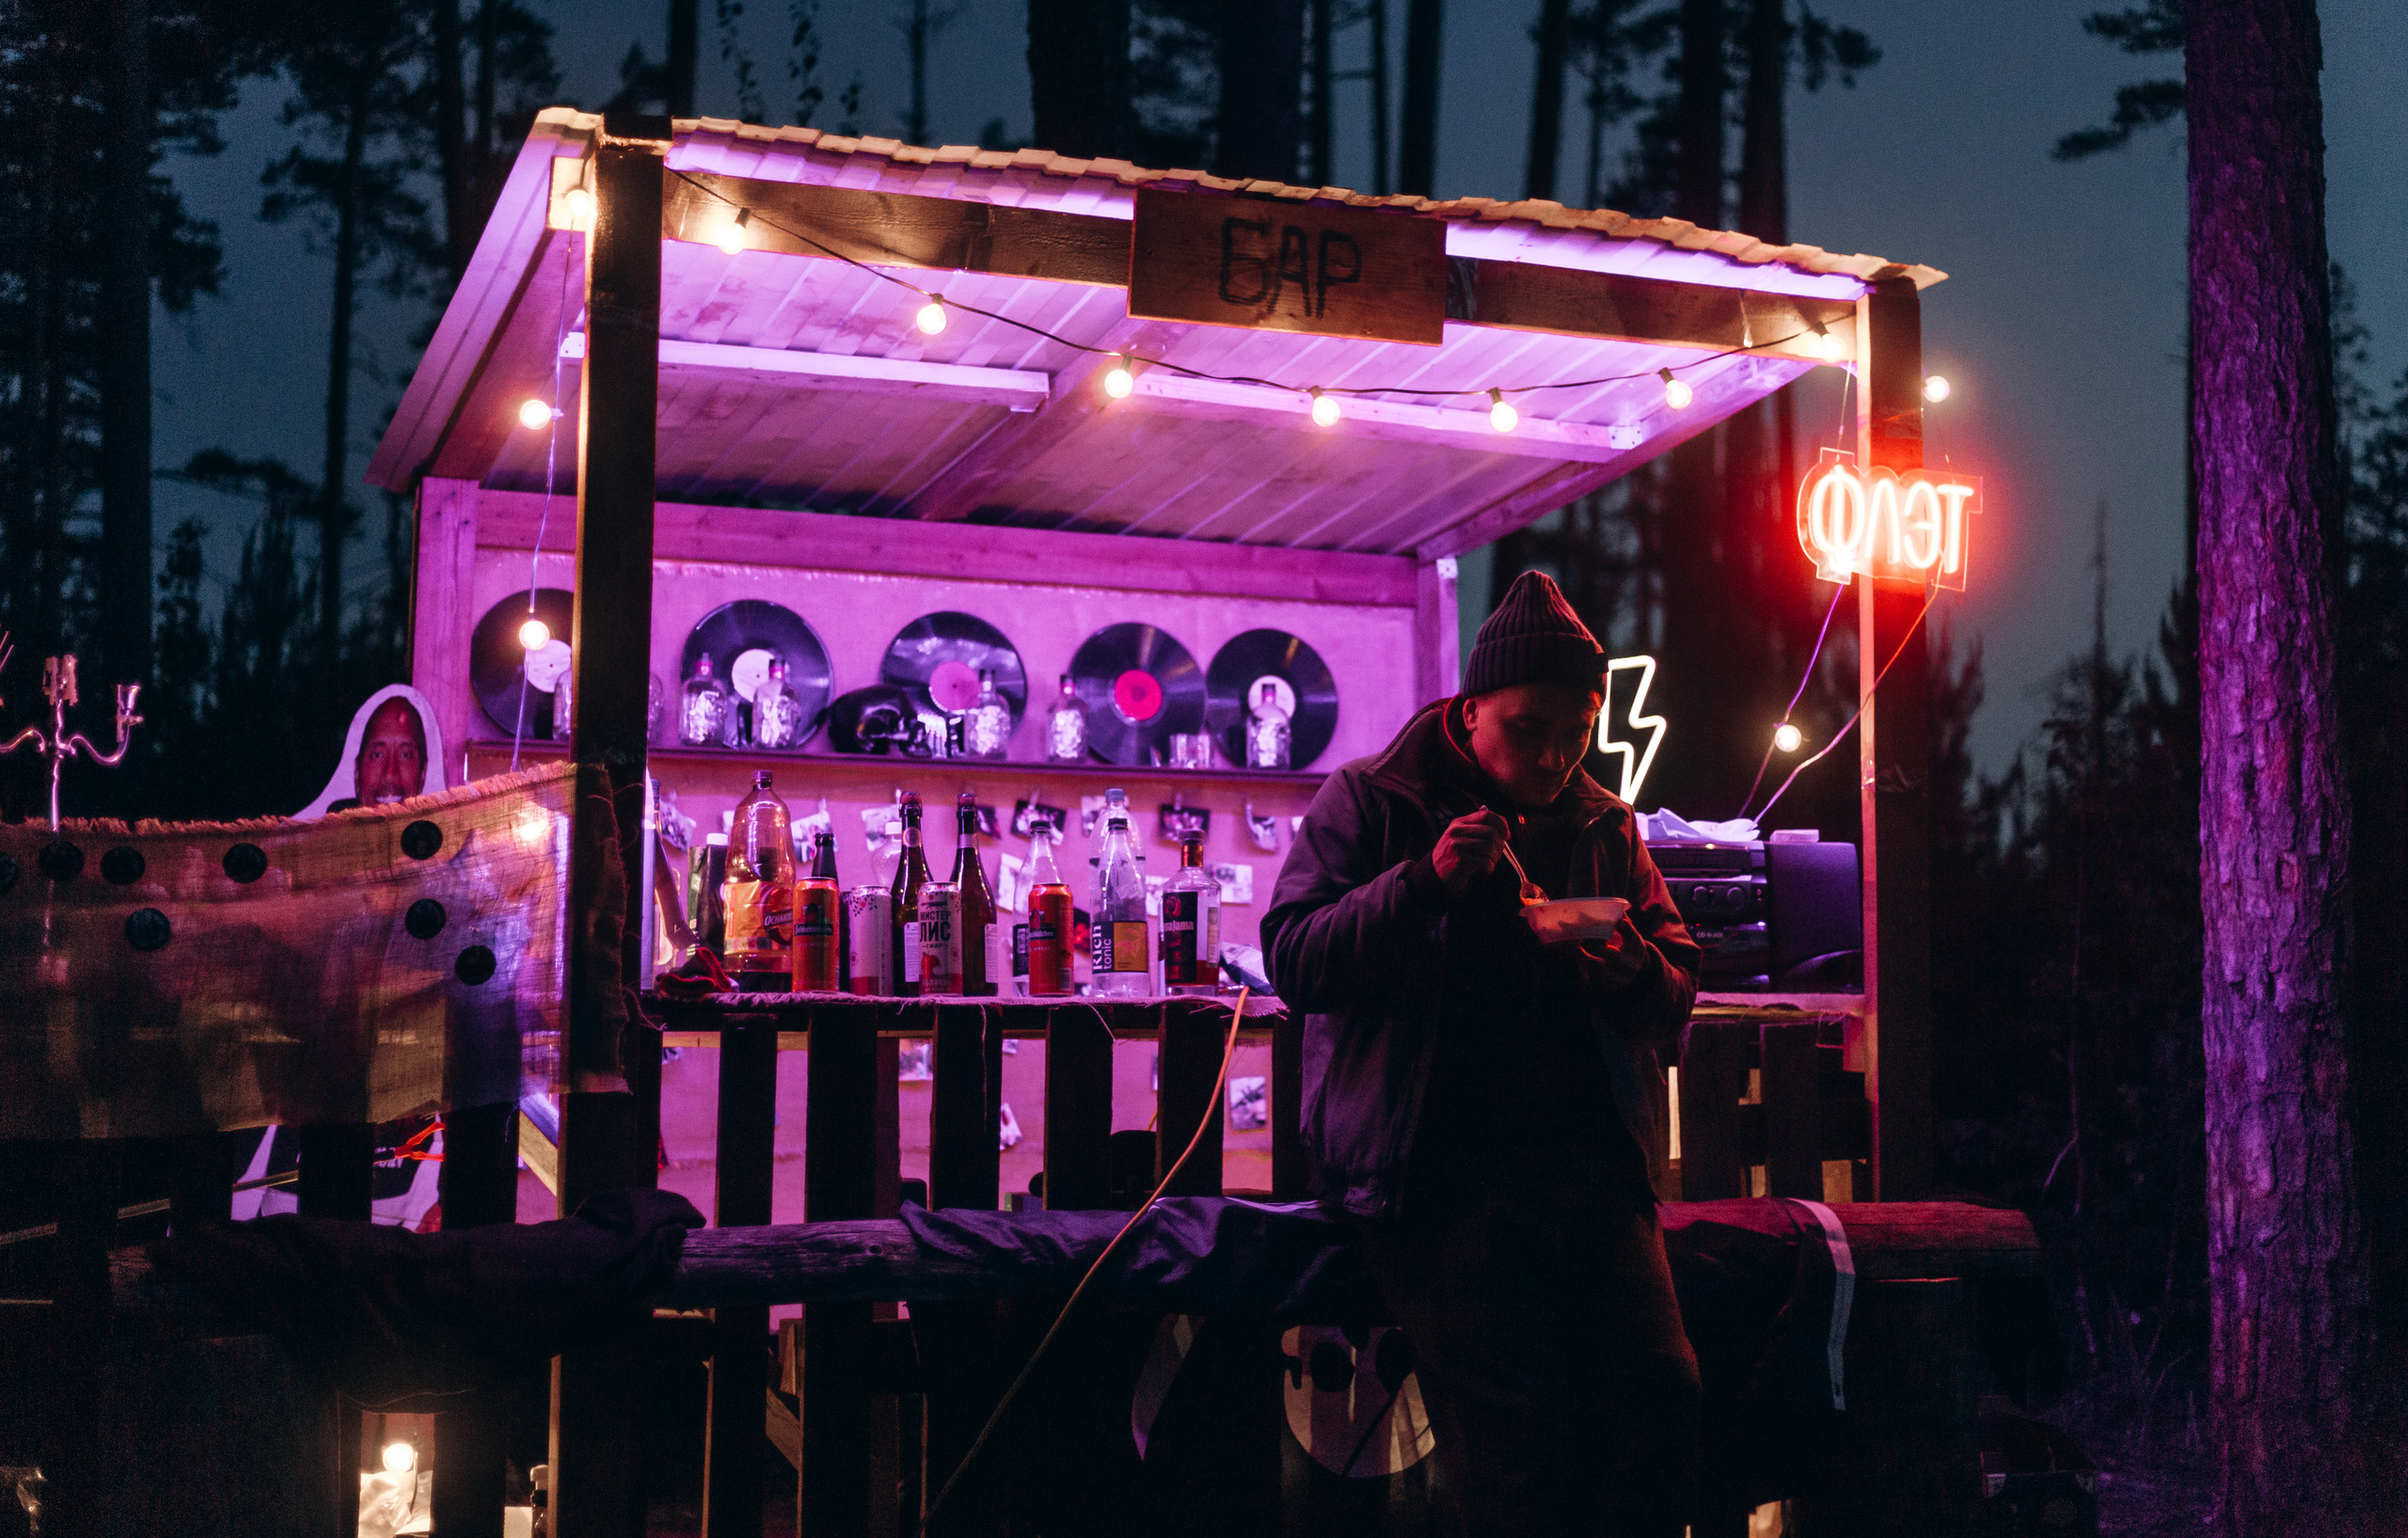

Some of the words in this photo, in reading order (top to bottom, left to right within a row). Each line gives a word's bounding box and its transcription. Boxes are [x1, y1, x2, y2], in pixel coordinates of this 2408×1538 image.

[1219, 217, 1362, 320] БАР
[1809, 464, 1974, 574] ФЛЭТ
[920, 910, 951, 921] МИСТЕР
[920, 921, 951, 942] ЛИС
[1101, 938, 1113, 970] tonic
